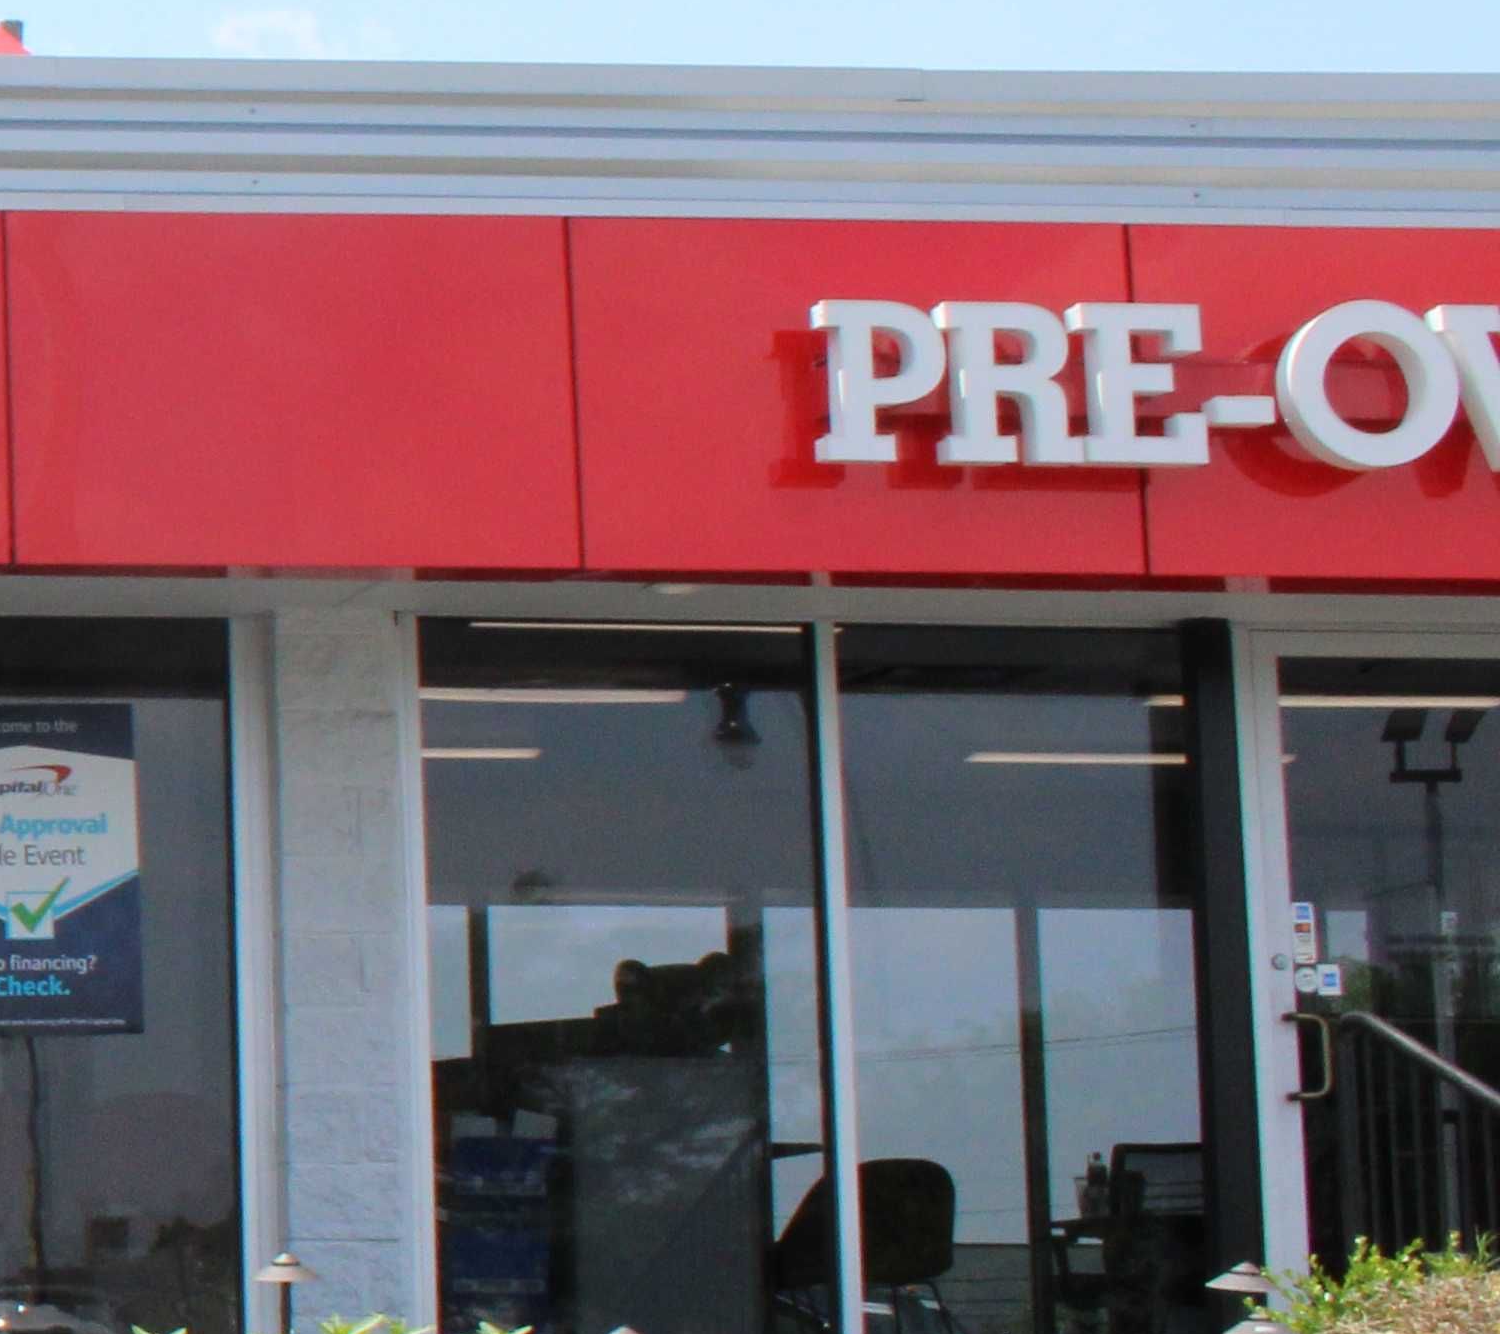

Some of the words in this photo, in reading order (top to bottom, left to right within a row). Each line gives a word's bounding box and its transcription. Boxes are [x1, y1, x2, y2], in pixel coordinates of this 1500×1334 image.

[35, 720, 51, 734] to
[53, 718, 78, 734] the
[24, 844, 86, 866] Event
[9, 954, 98, 975] financing?
